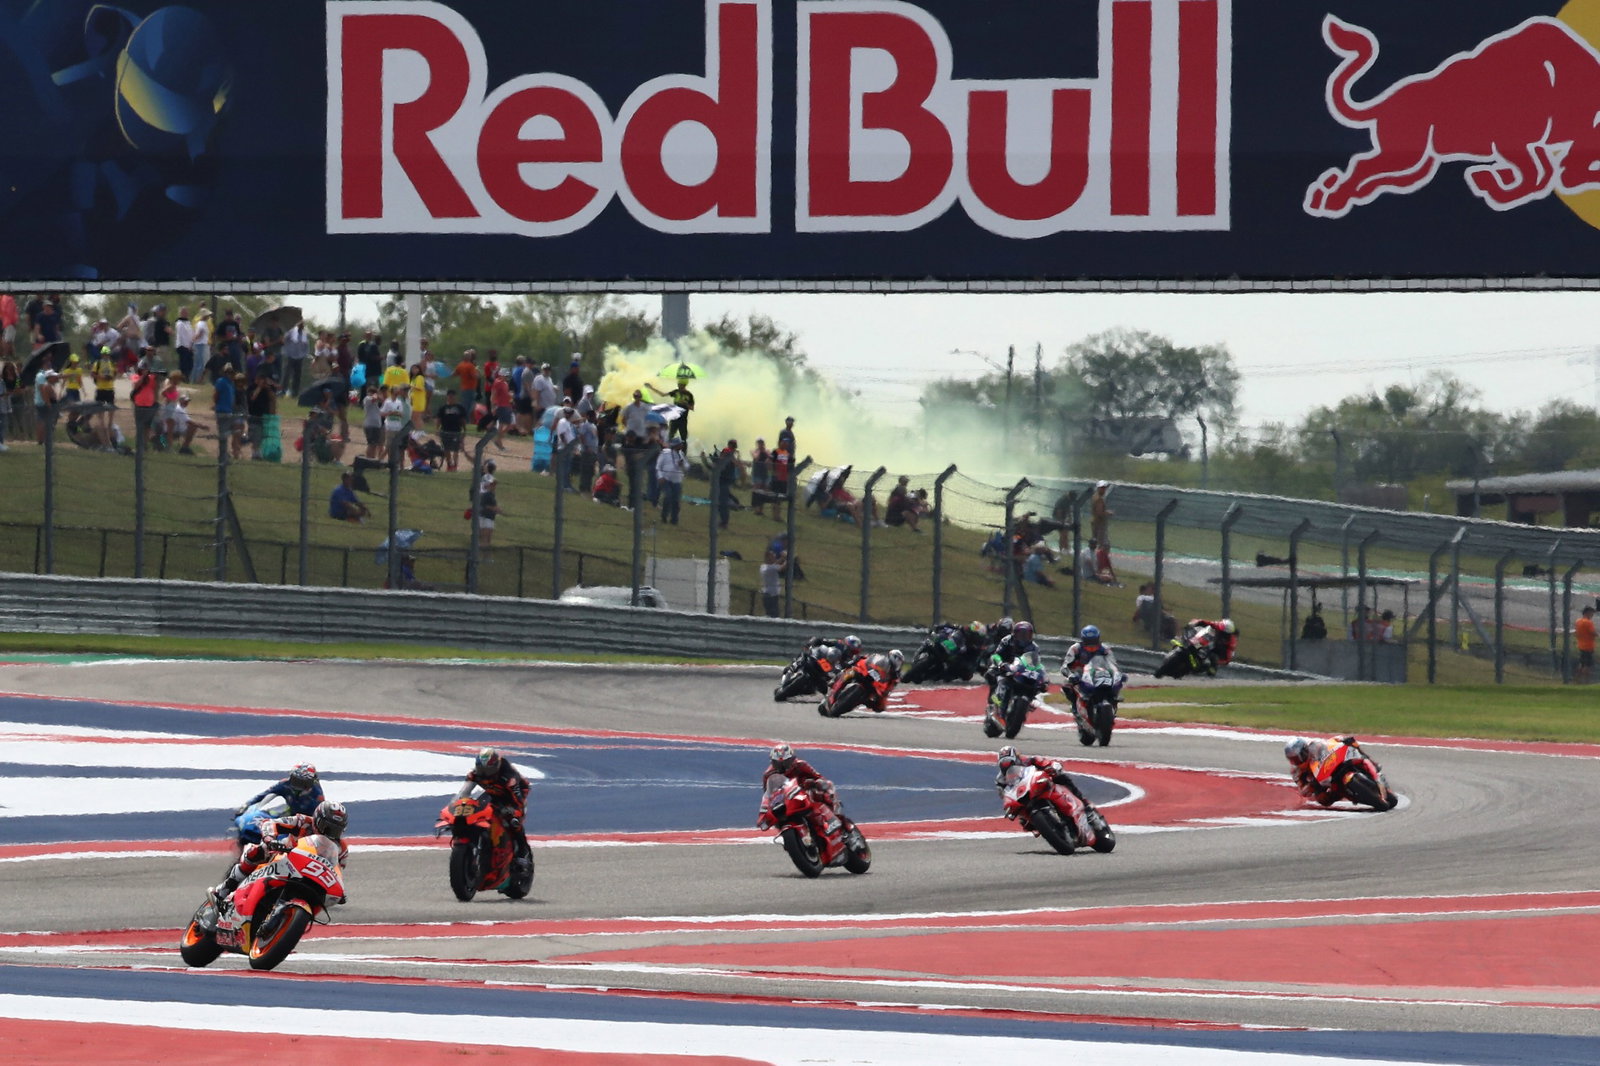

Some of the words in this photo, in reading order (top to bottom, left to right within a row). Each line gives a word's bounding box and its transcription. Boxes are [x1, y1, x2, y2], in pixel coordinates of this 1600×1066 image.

[327, 0, 771, 236] Red
[795, 0, 1231, 238] Bull
[244, 863, 281, 885] REPSOL
[301, 861, 337, 888] 93
